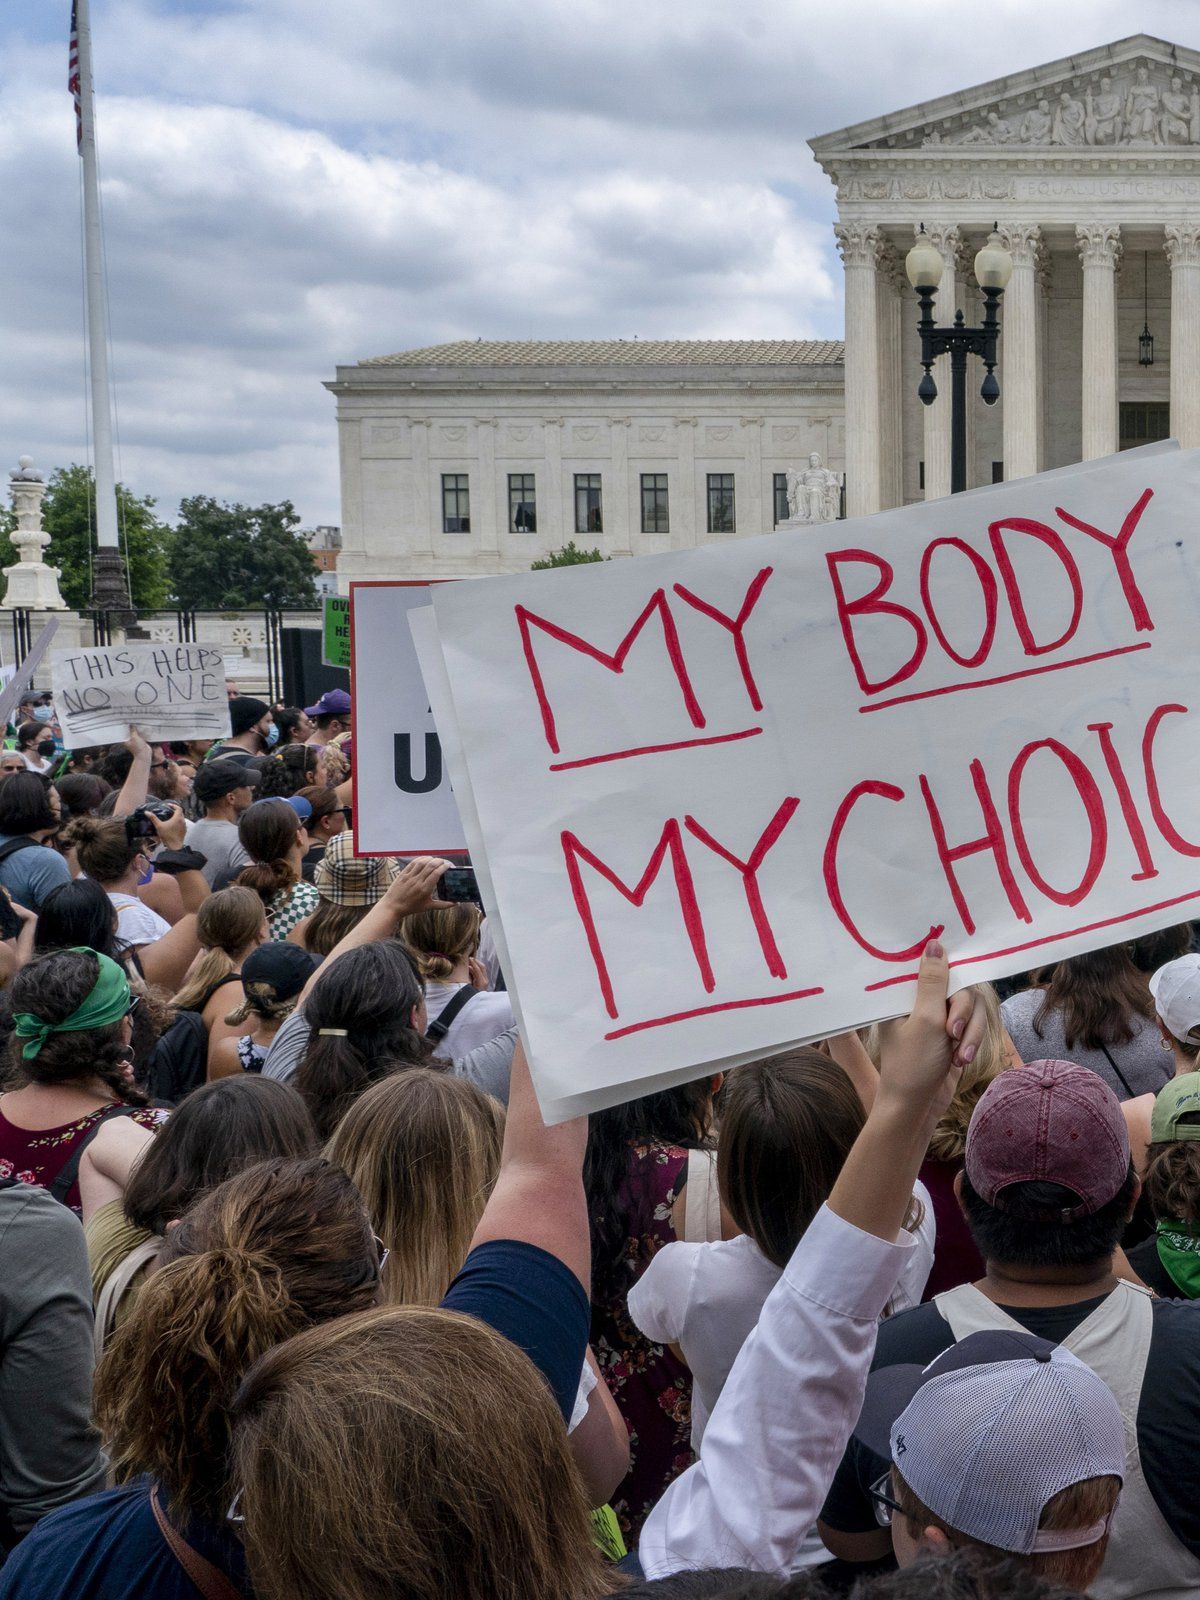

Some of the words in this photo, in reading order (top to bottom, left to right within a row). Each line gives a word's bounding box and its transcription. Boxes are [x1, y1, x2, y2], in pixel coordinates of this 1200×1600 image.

[1028, 182, 1084, 195] EQUAL
[1090, 182, 1154, 196] JUSTICE
[515, 566, 773, 754] MY
[826, 489, 1154, 695] BODY
[65, 652, 135, 681] THIS
[152, 648, 223, 678] HELPS
[62, 687, 111, 713] NO
[135, 673, 220, 705] ONE
[560, 797, 799, 1019] MY
